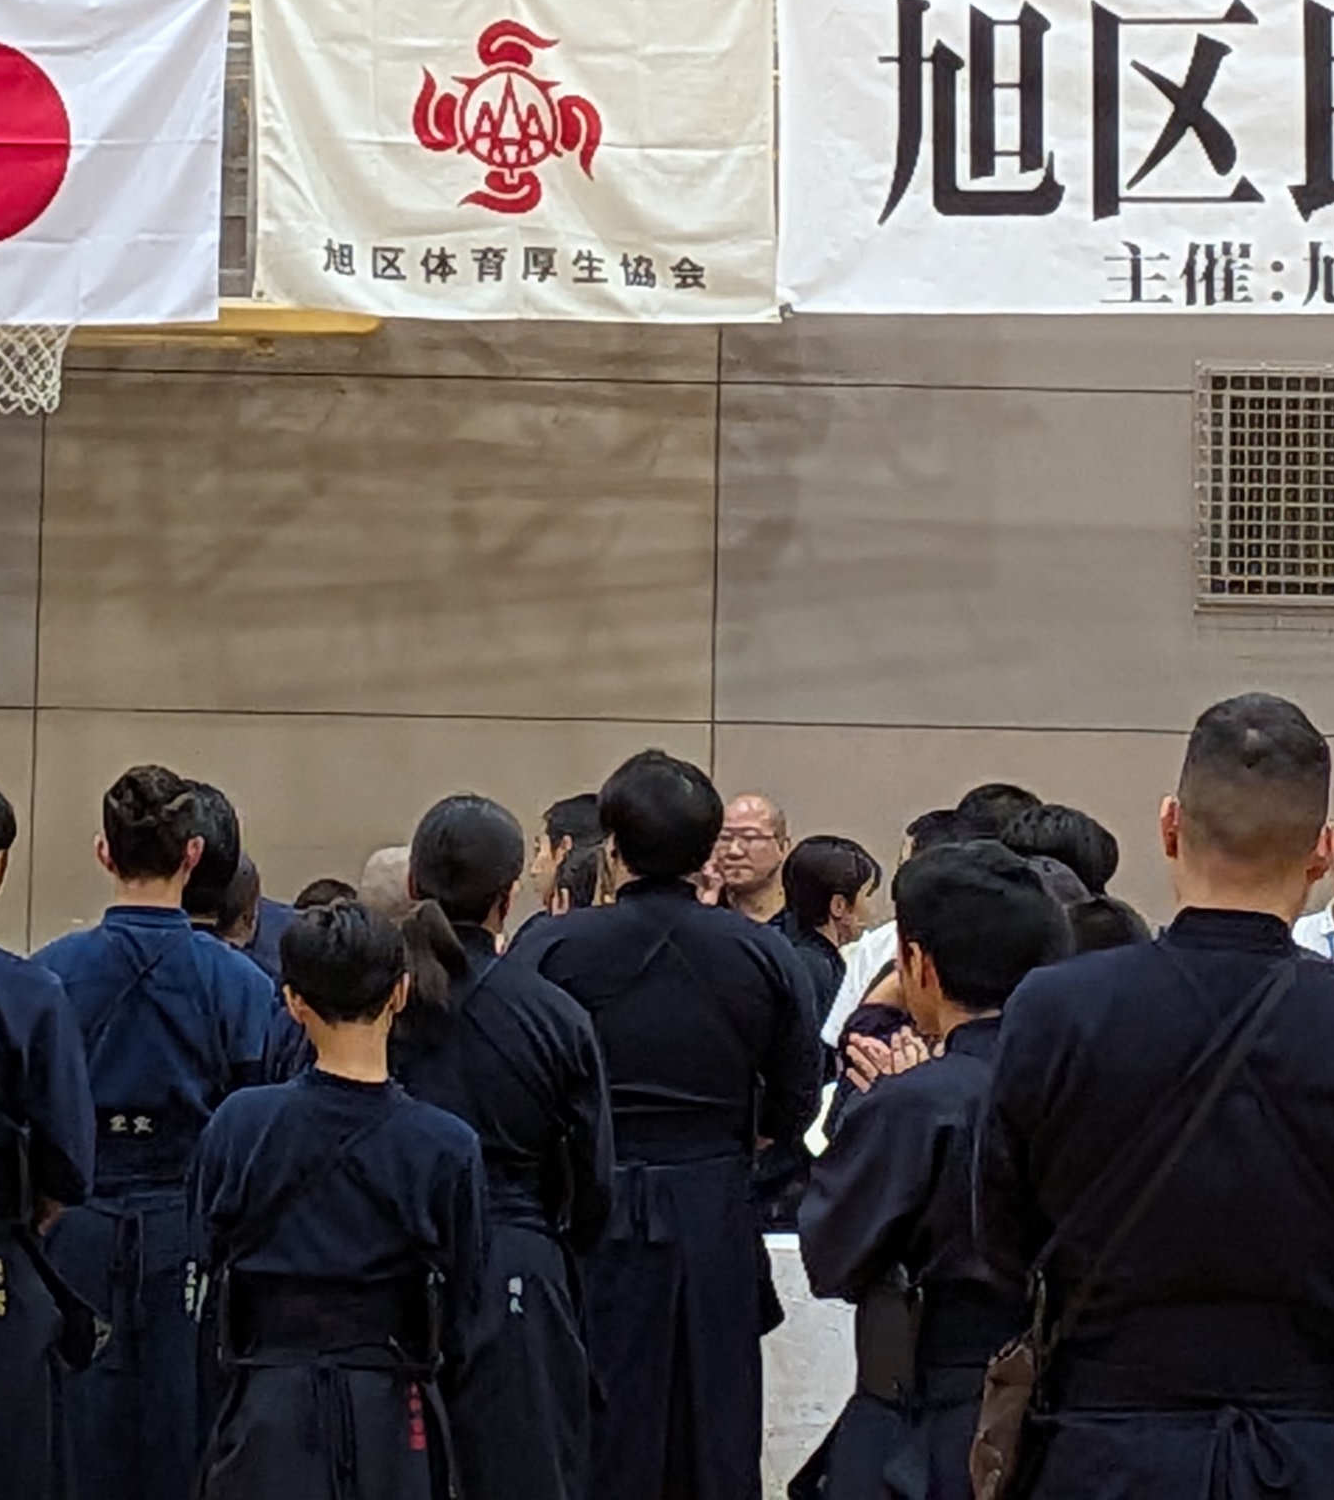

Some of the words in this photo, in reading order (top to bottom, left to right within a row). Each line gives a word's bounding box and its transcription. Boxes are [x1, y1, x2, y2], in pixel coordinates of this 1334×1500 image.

[322, 237, 708, 291] 旭区体育厚生協会
